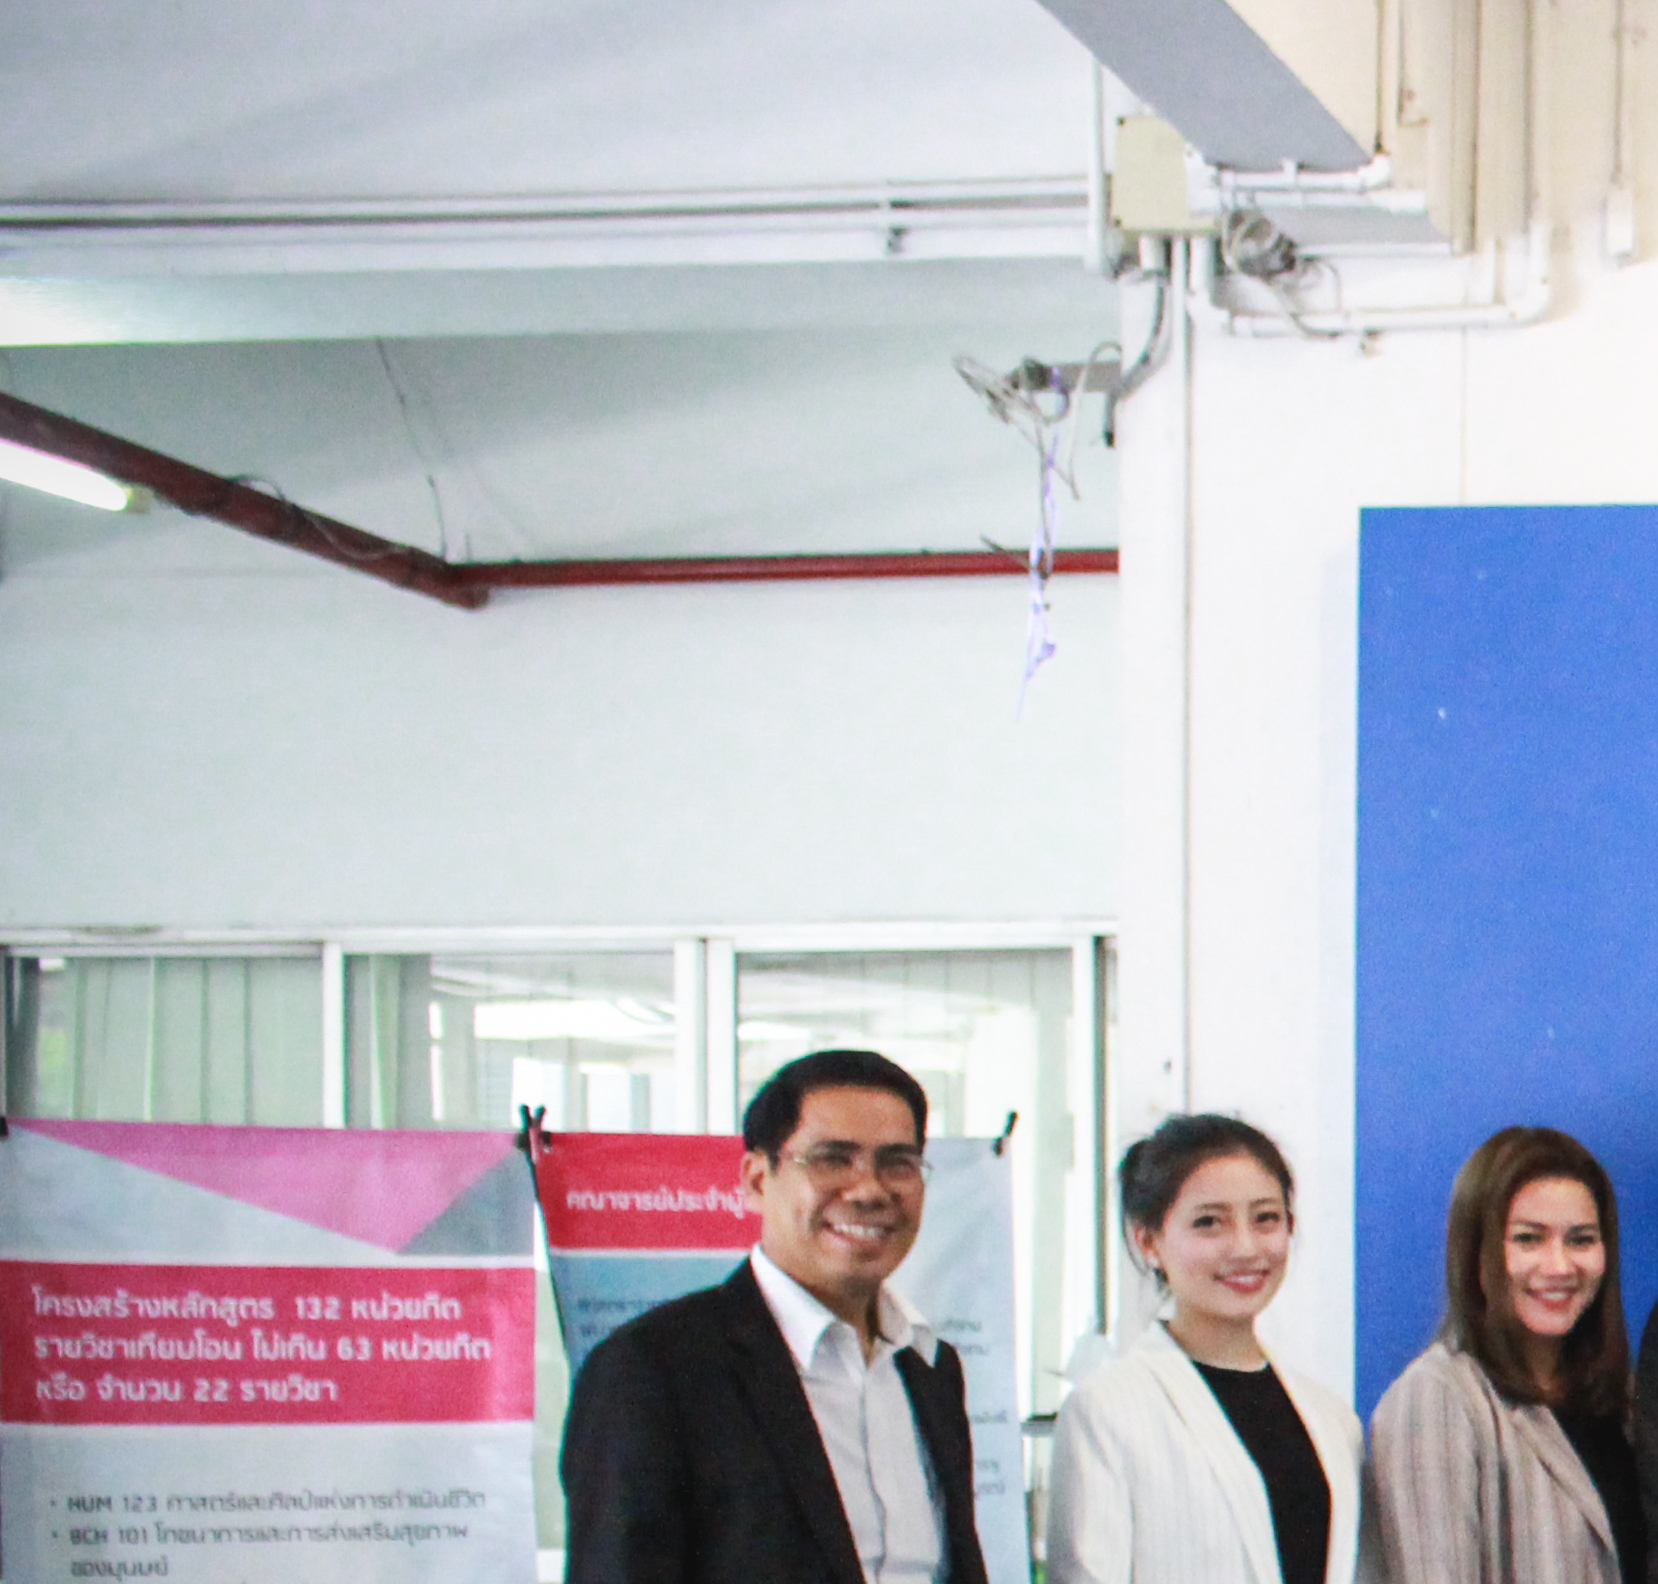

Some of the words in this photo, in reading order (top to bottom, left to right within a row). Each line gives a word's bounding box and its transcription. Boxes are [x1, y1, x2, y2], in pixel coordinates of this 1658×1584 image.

[31, 1284, 275, 1328] โครงสร้างหลักสูตร
[294, 1295, 342, 1320] 132
[350, 1289, 463, 1321] หน่วยกิต
[250, 1327, 327, 1360] ไม่เกิน
[336, 1335, 372, 1361] 63
[380, 1331, 493, 1361] หน่วยกิต
[34, 1370, 86, 1401] หรือ
[98, 1371, 182, 1402] จำนวน
[192, 1376, 230, 1402] 22
[238, 1371, 340, 1402] รายวิชา
[67, 1496, 112, 1513] HUM
[117, 1526, 148, 1545] 101
